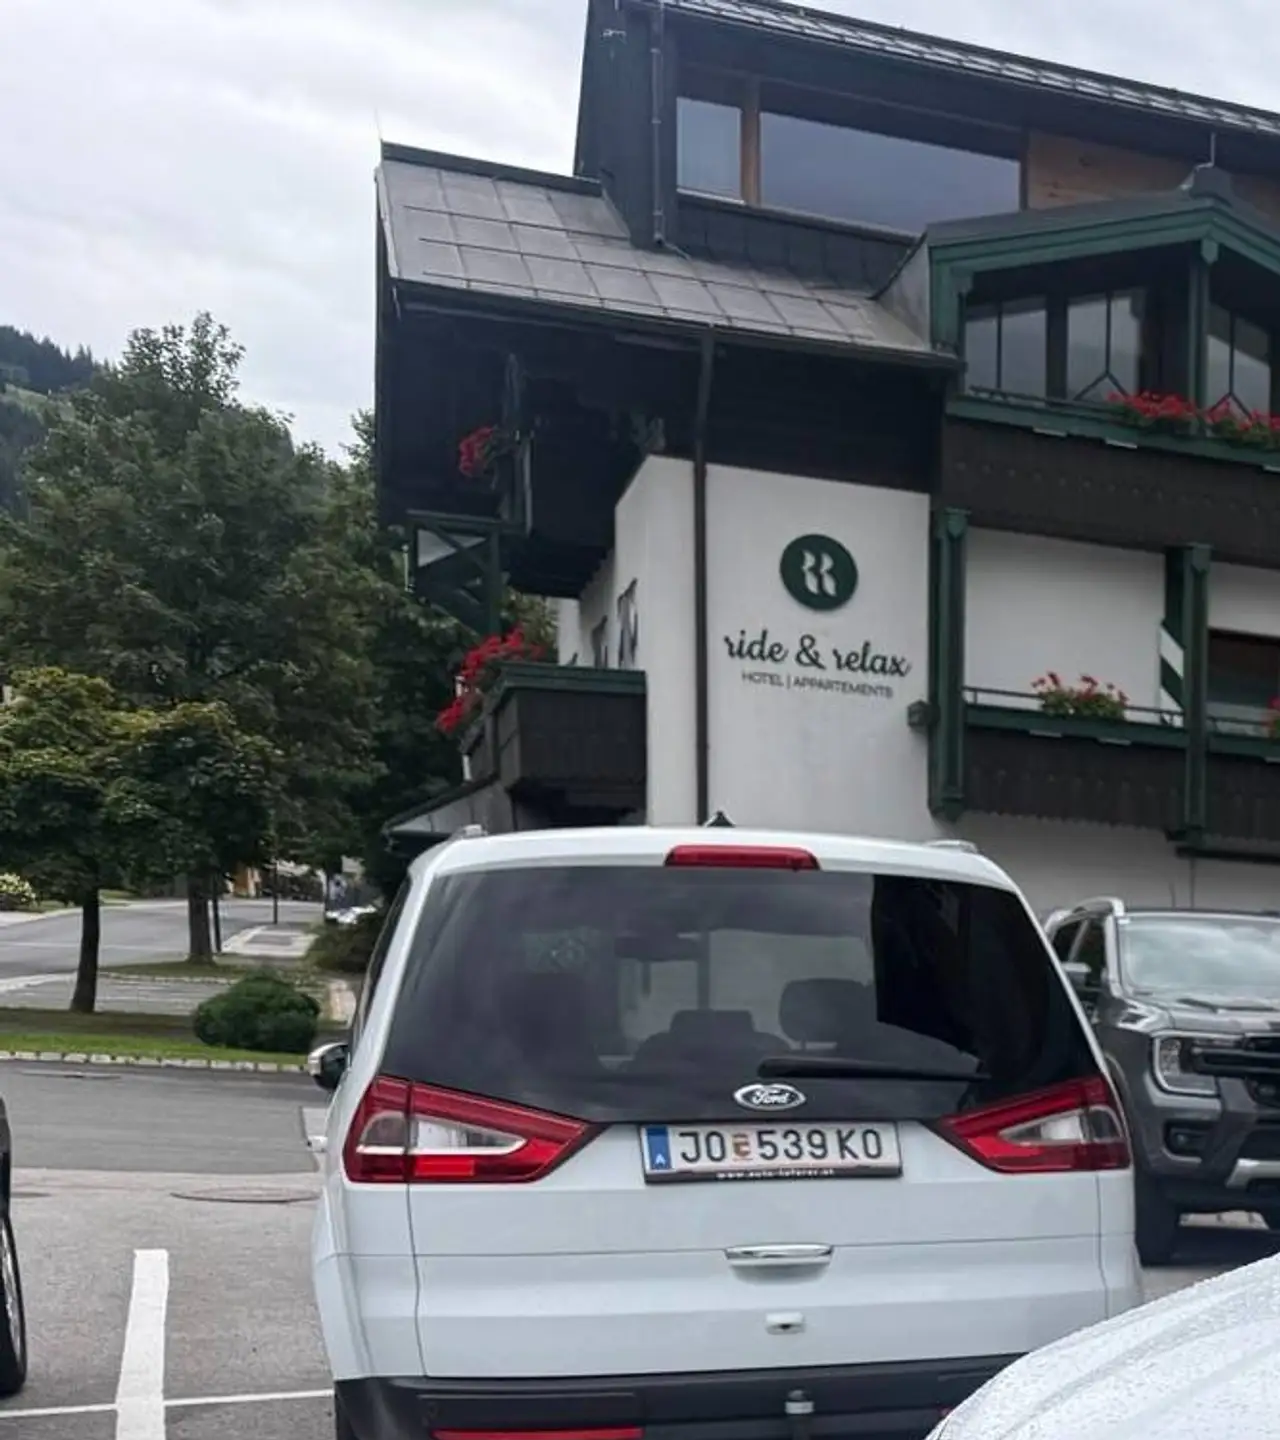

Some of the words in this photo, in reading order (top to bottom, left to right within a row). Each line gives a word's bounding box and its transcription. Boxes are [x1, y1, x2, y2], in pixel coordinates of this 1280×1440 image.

[723, 627, 789, 663] ride
[795, 634, 826, 670] &
[832, 640, 912, 678] relax
[741, 671, 784, 687] HOTEL
[793, 677, 894, 699] APPARTEMENTS
[752, 1087, 790, 1104] Ford
[679, 1131, 726, 1163] JO
